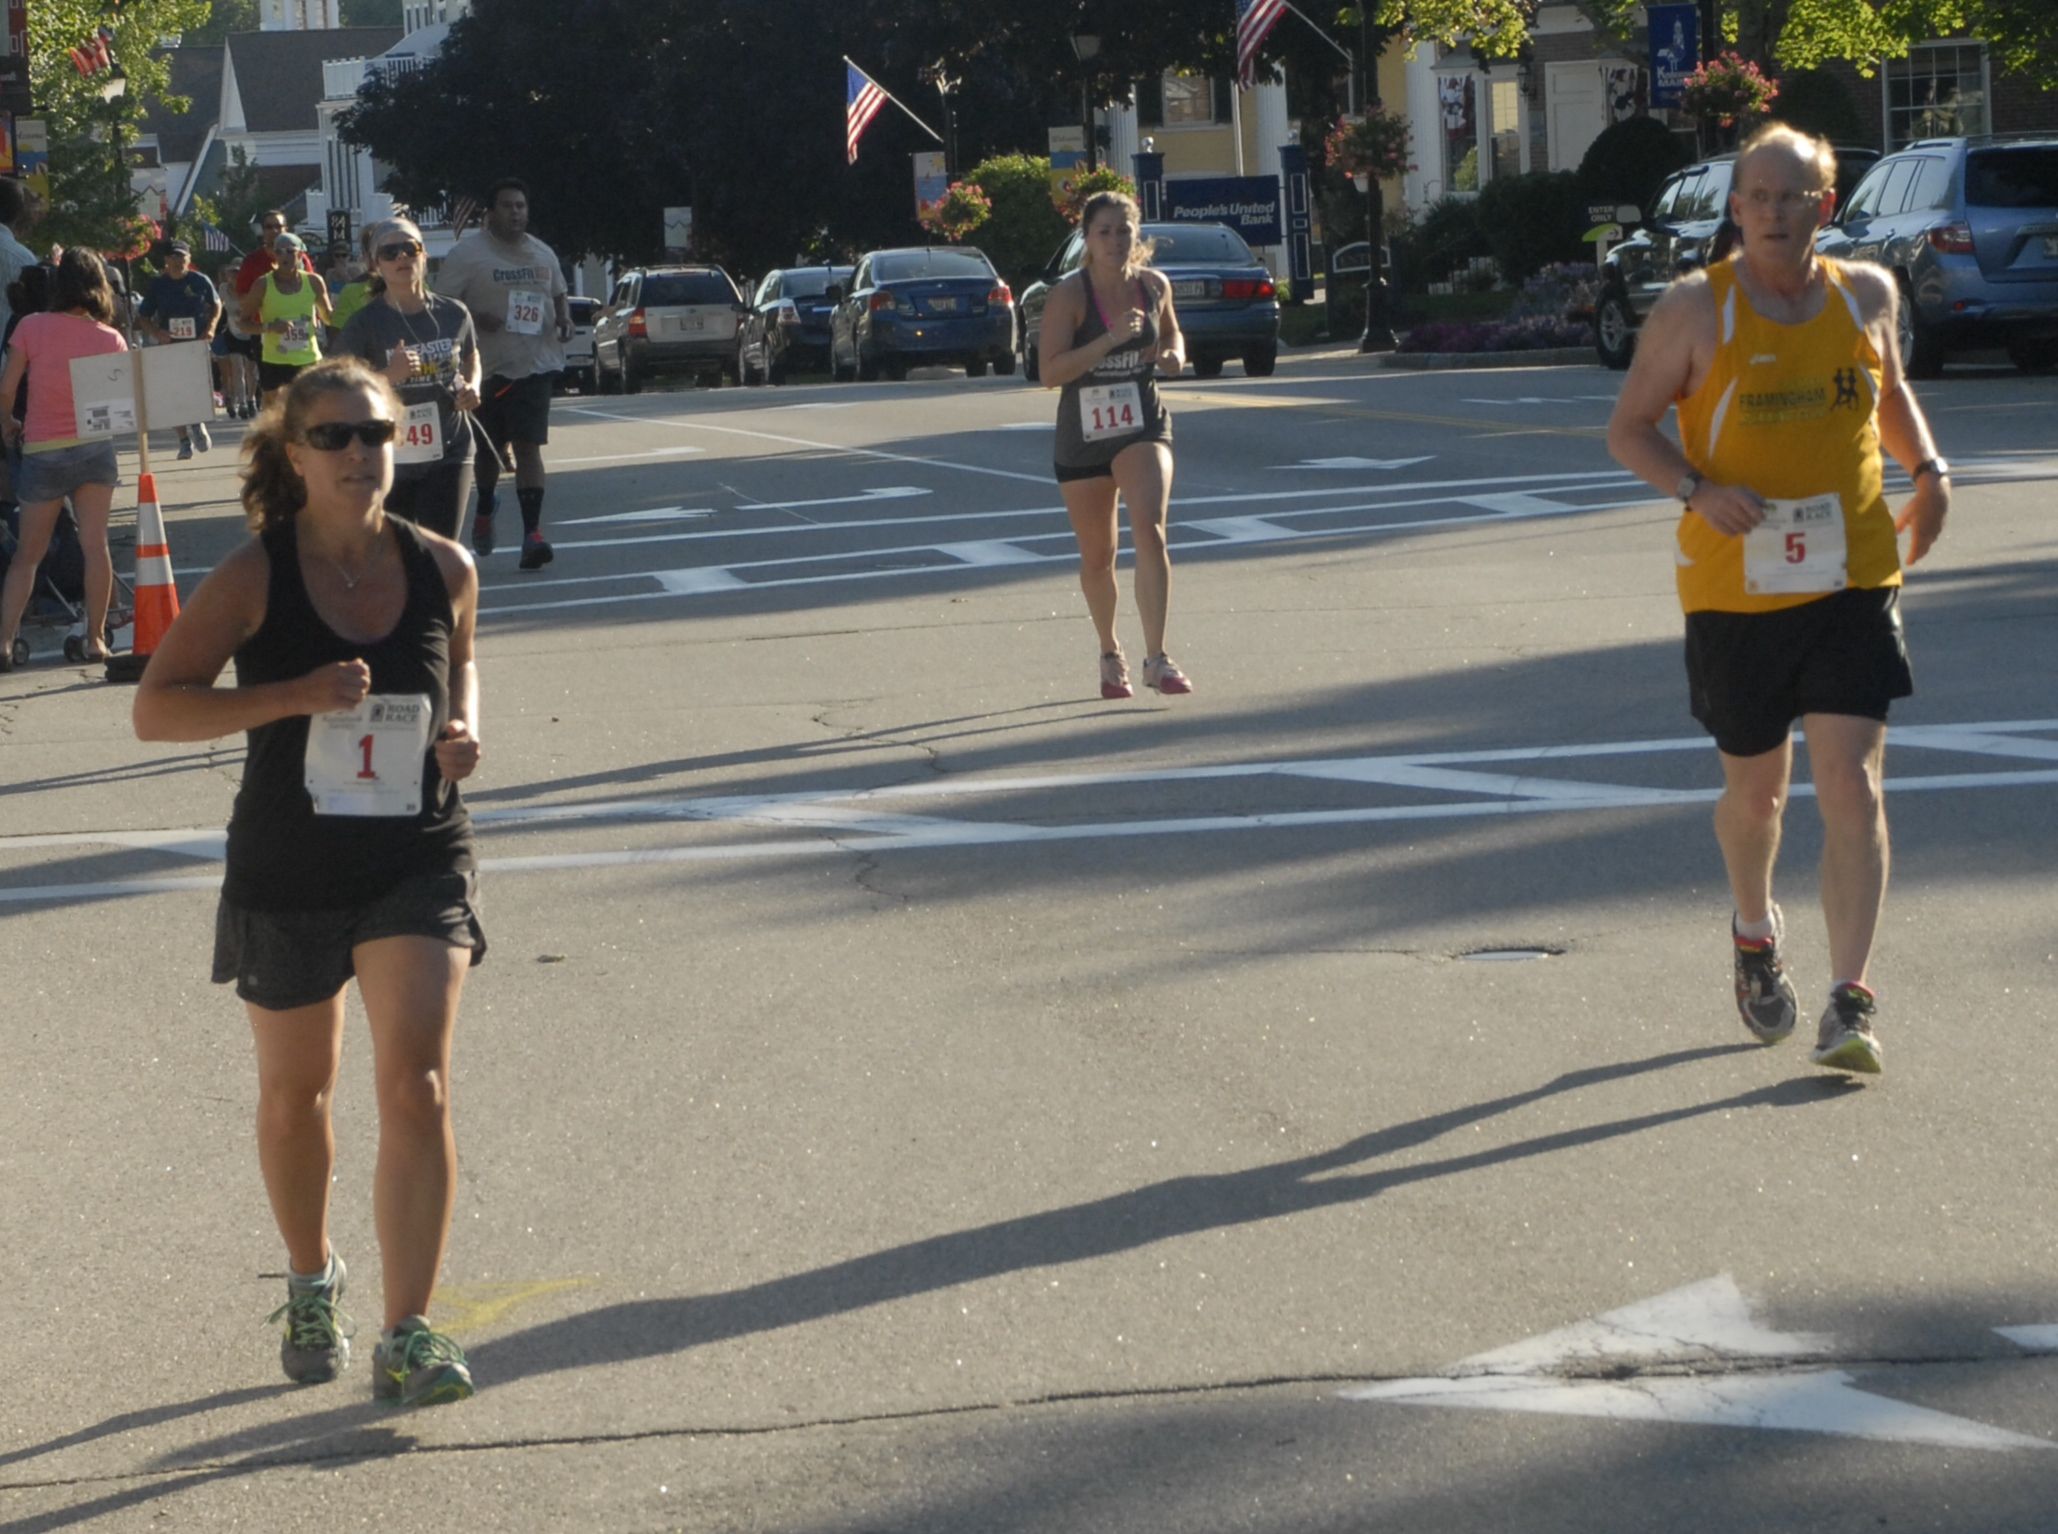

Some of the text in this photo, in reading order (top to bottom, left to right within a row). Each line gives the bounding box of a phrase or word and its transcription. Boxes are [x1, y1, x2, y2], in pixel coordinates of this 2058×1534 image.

[1173, 201, 1275, 219] People's United
[1588, 206, 1614, 214] ENTER
[1590, 214, 1612, 222] ONLY
[1240, 214, 1274, 226] Bank
[513, 304, 540, 323] 326
[1091, 403, 1135, 430] 114
[400, 423, 433, 446] 49
[1784, 531, 1807, 564] 5
[356, 733, 378, 780] 1
